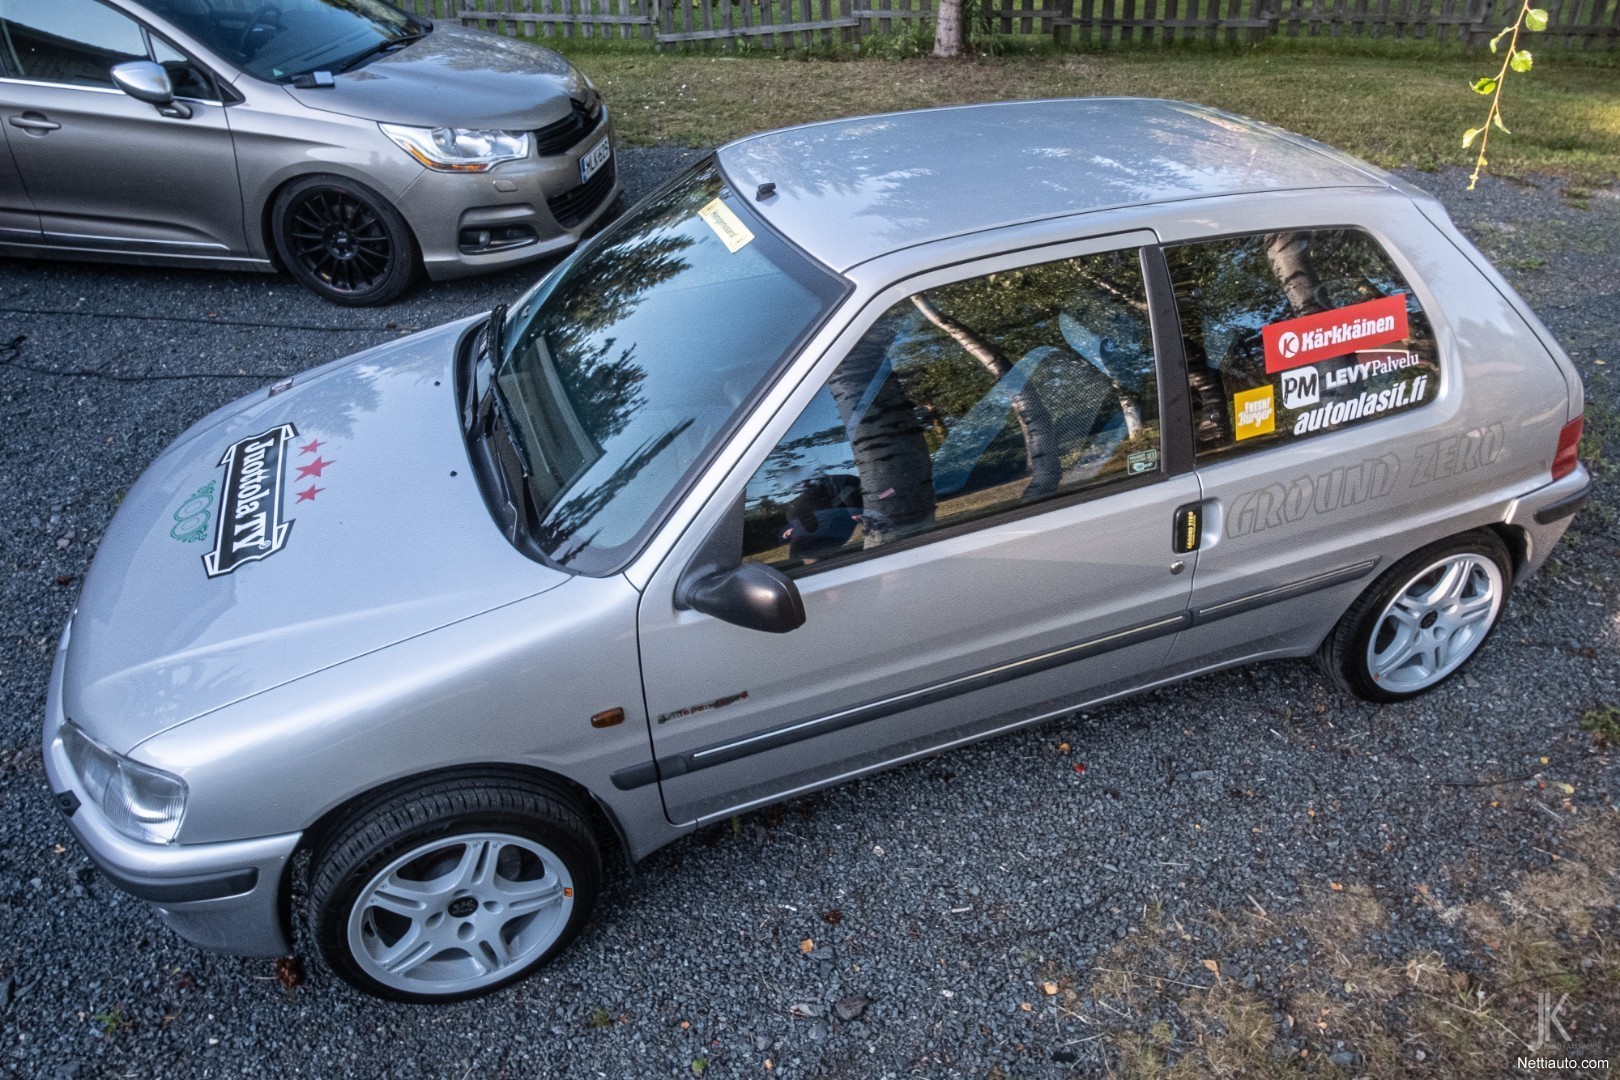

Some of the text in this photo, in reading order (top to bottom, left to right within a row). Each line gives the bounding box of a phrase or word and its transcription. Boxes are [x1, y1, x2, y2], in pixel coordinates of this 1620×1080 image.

[1301, 315, 1395, 352] Kärkkäinen
[1244, 396, 1271, 412] FRESH!
[1284, 372, 1318, 406] PM
[1293, 375, 1428, 436] autonlasit.fi
[1237, 407, 1273, 428] Burger
[232, 437, 275, 553] Juottola TV
[1226, 453, 1401, 539] GROUND
[1409, 421, 1504, 488] ZERO
